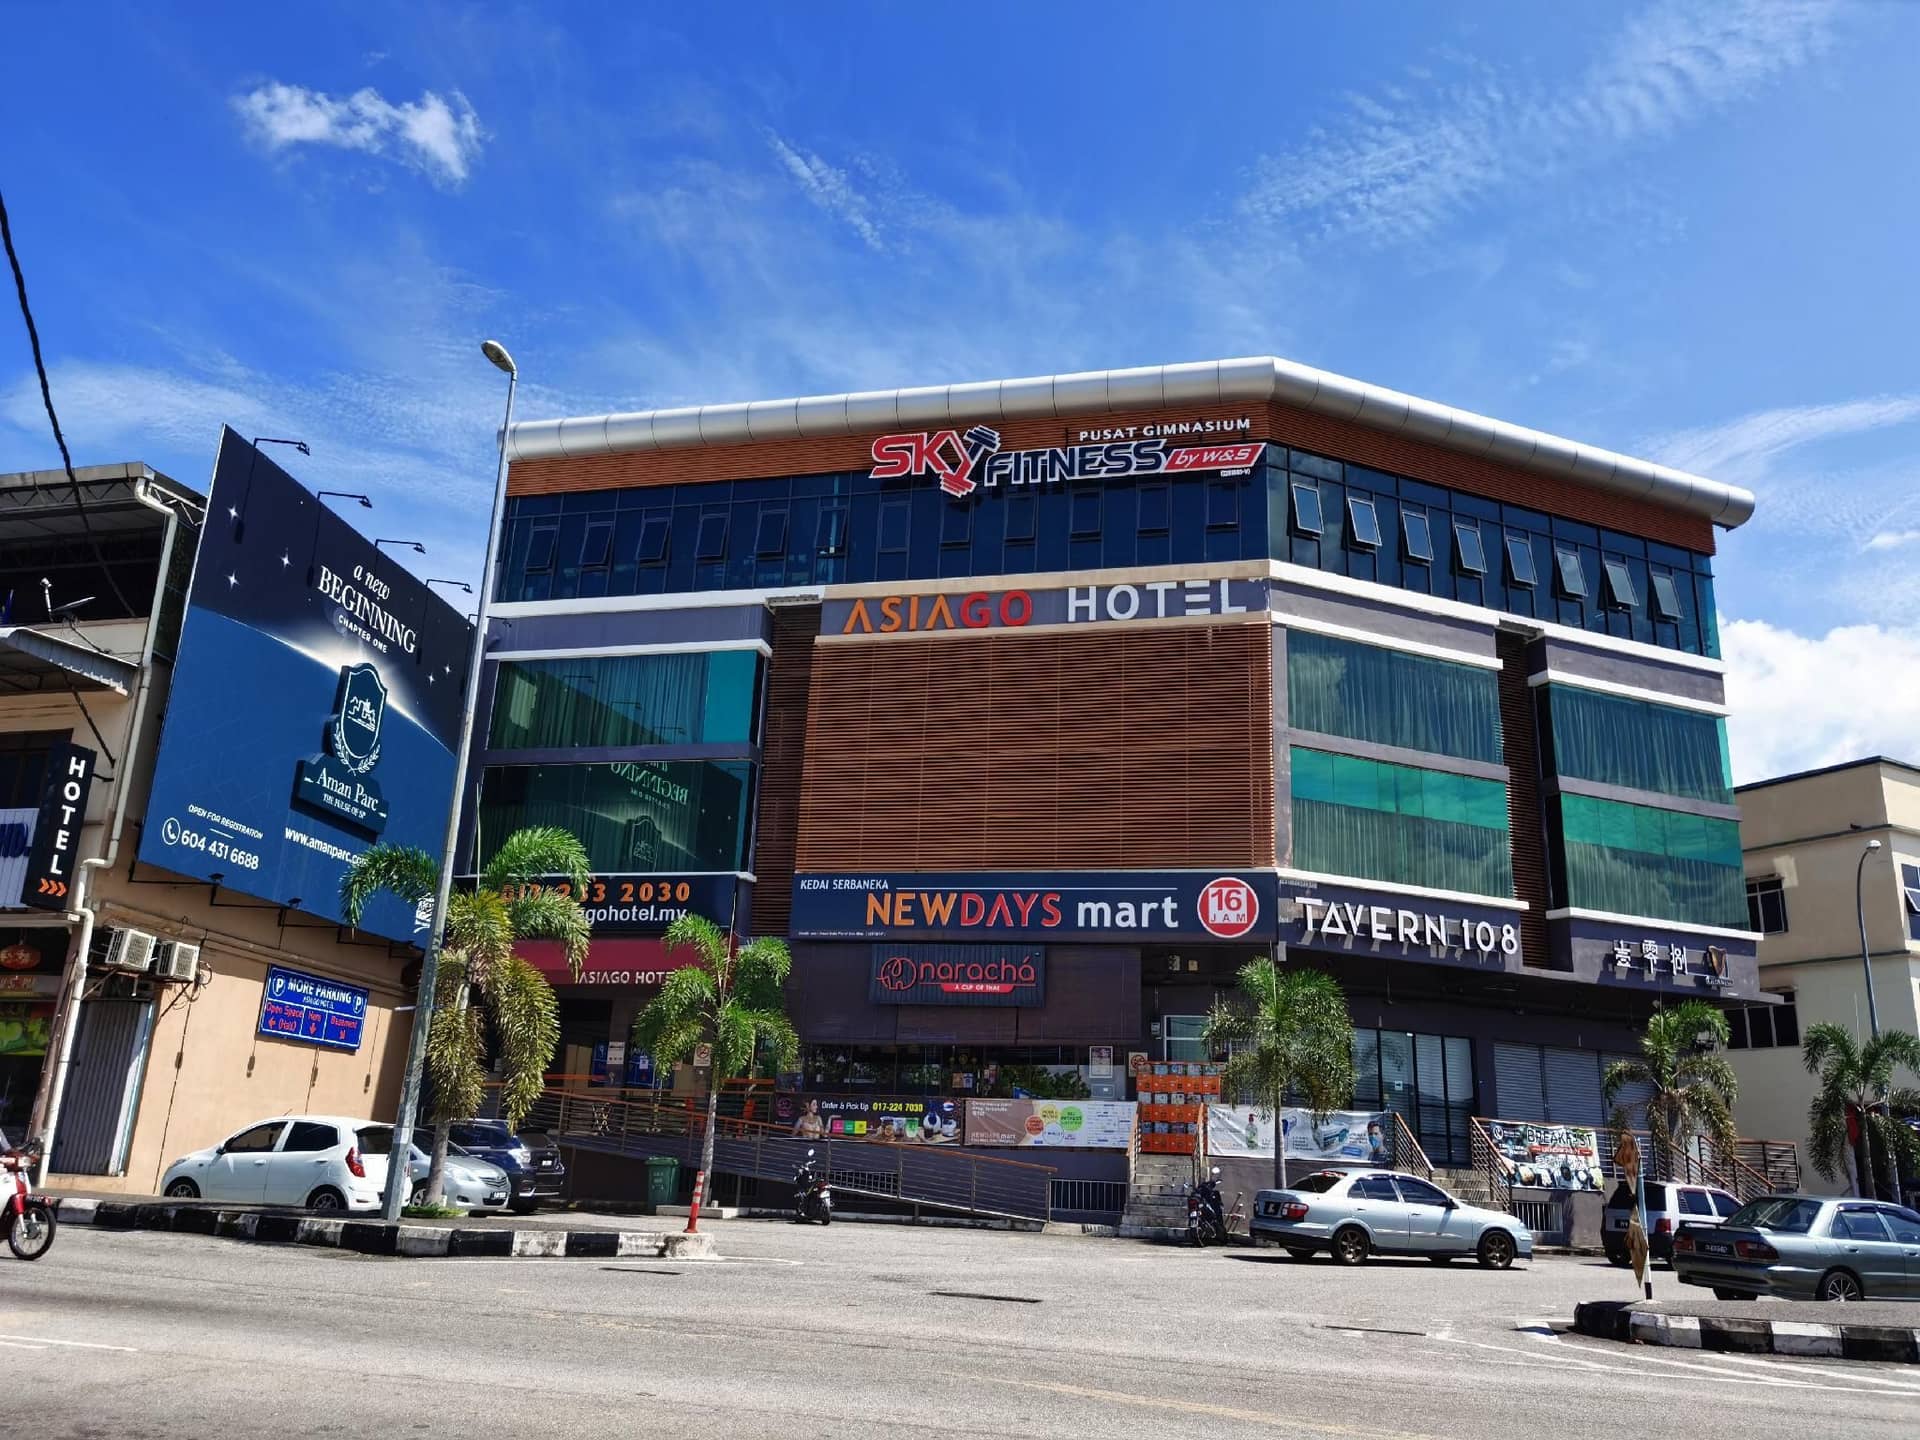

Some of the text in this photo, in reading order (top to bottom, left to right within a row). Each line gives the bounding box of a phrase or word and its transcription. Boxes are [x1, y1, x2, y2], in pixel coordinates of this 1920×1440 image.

[1079, 418, 1252, 441] PUSAT GIMNASIUM
[869, 425, 1252, 498] SKY FITNESS by W&S
[353, 565, 390, 600] a new
[318, 565, 416, 653] BEGINNING
[843, 578, 1248, 634] ASIAGO HOTEL
[339, 615, 387, 653] CHAPTER ONE
[316, 767, 379, 812] Aman Parc
[50, 756, 86, 875] HOTEL
[188, 804, 263, 839] OPEN FOR REGISTRATION
[181, 830, 259, 870] 604 431 6688
[620, 882, 690, 902] 2030
[800, 879, 889, 890] KEDAI SERBANEKA
[1211, 889, 1243, 911] 16
[866, 892, 1179, 928] NEWDAYS mart
[1210, 913, 1246, 923] JAM
[1295, 896, 1519, 954] TAVERN 108
[287, 978, 314, 997] MORE
[315, 985, 353, 1004] PARKING
[579, 971, 630, 984] ASIAGO
[266, 1002, 282, 1013] Open
[284, 1006, 303, 1018] Space
[821, 1101, 839, 1110] Order
[846, 1102, 859, 1110] Pick
[860, 1103, 869, 1112] Up
[872, 1102, 903, 1112] 017-224
[905, 1103, 923, 1112] 7030
